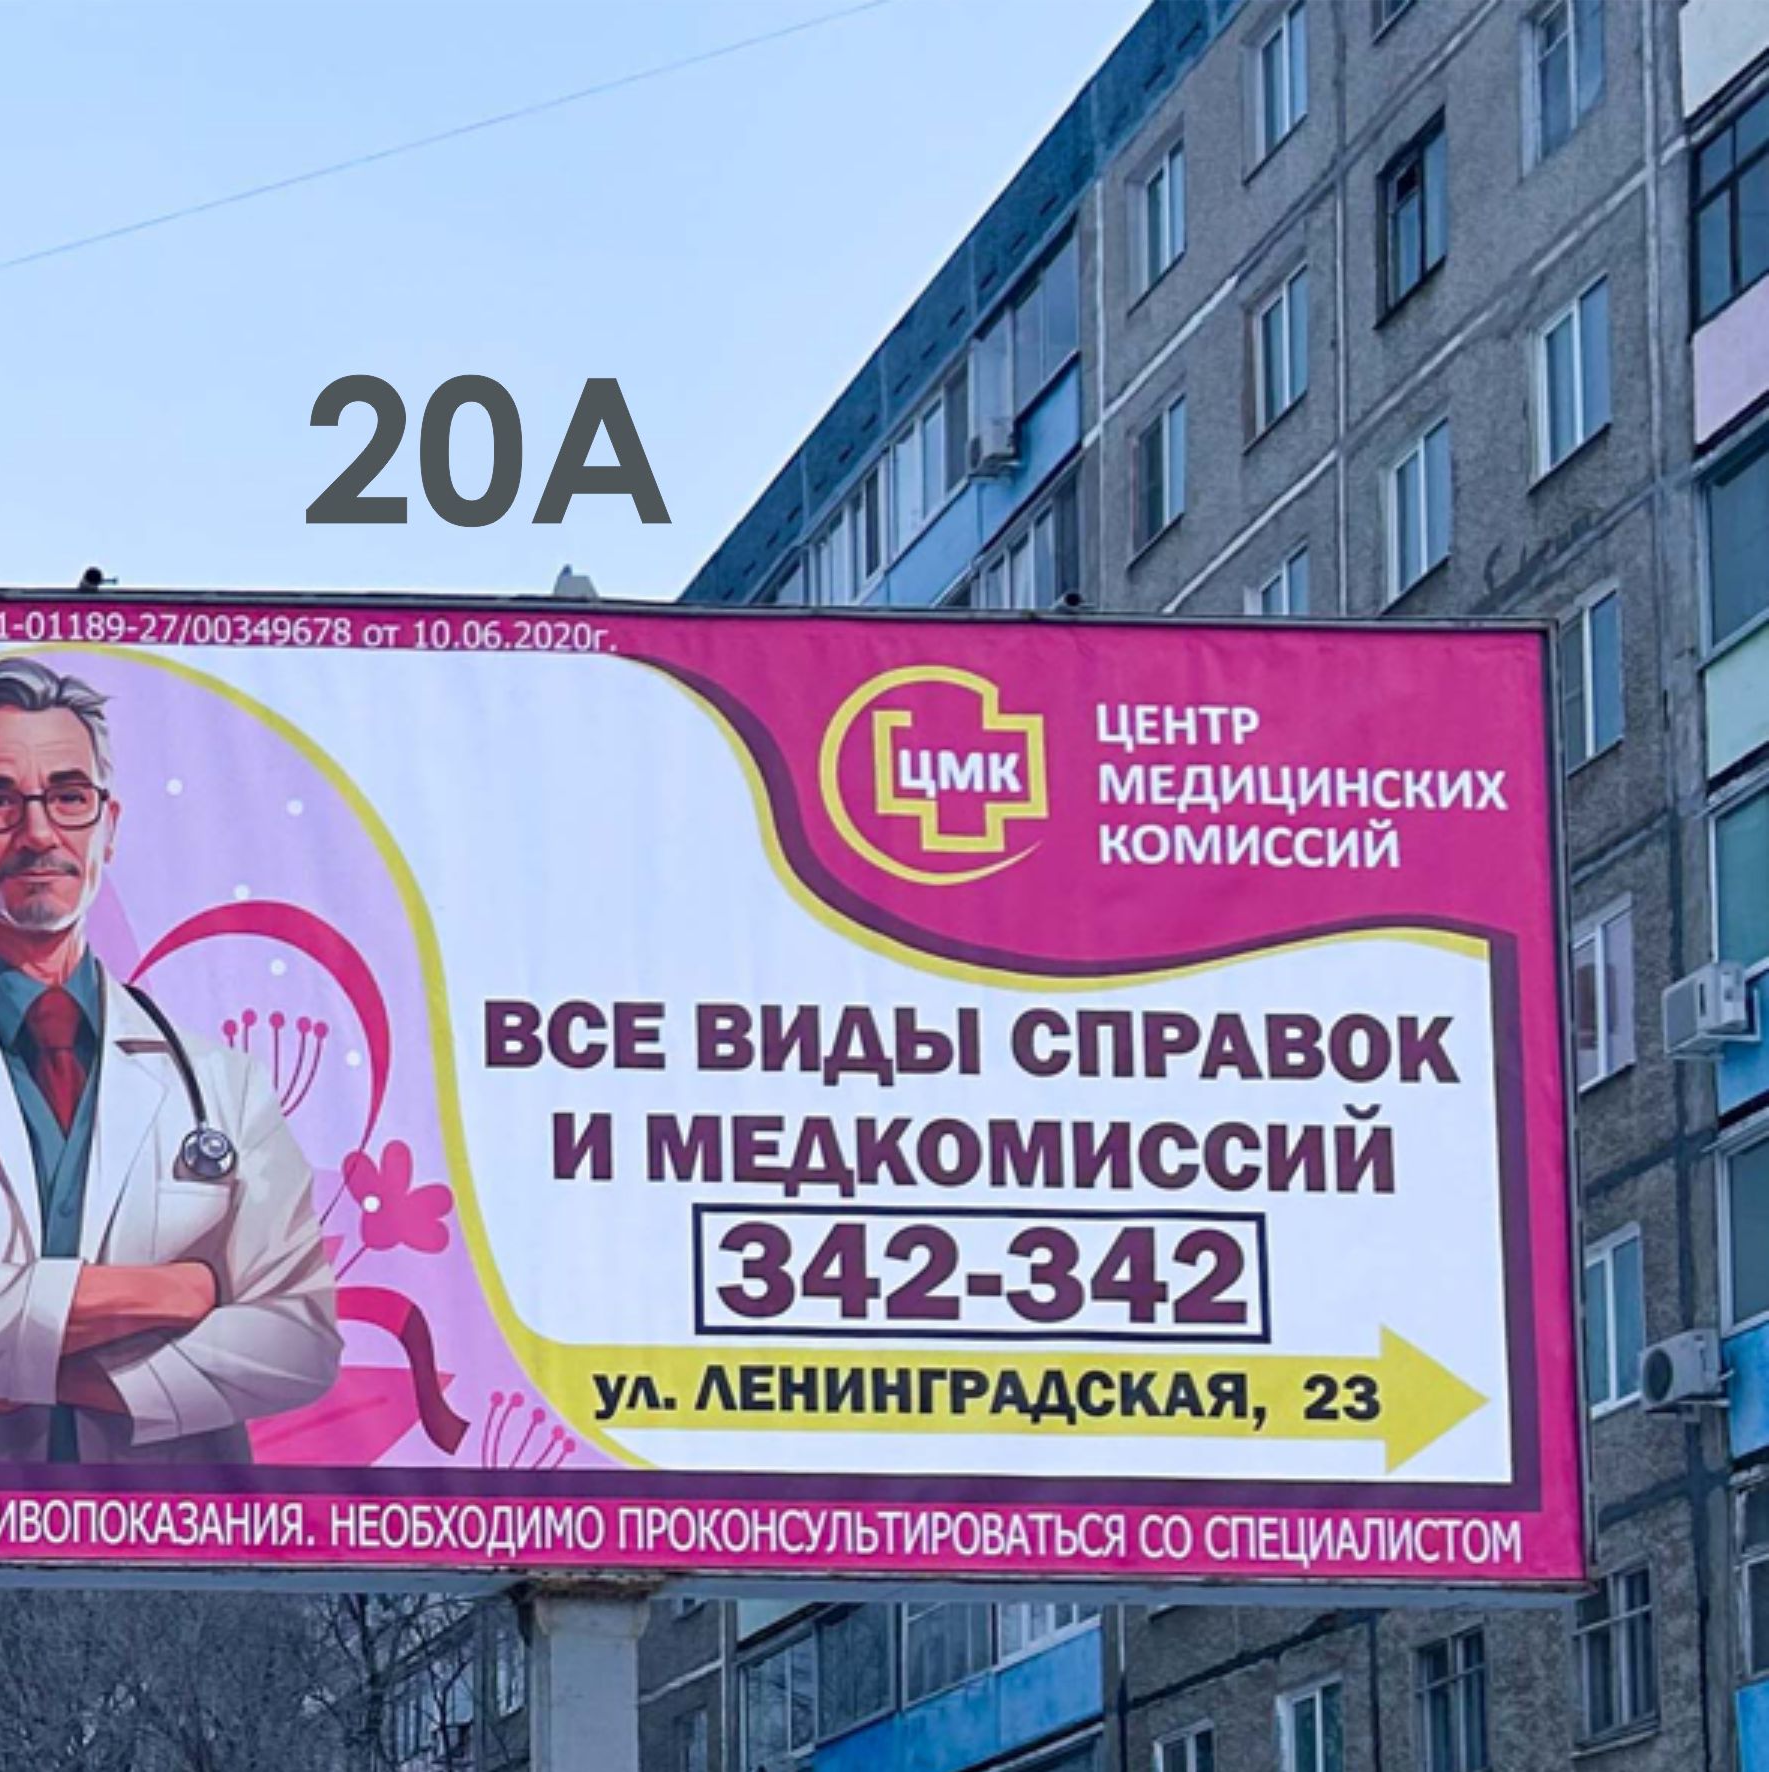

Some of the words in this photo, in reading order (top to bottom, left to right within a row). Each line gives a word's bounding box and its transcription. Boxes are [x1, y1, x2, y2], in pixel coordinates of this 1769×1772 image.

[363, 624, 398, 649] от
[412, 619, 618, 654] 10.06.2020г.
[1096, 703, 1261, 753] ЦЕНТР
[898, 748, 1023, 798] ЦМК
[1097, 763, 1509, 816] МЕДИЦИНСКИХ
[1098, 818, 1401, 869] КОМИССИЙ
[484, 1000, 666, 1070] ВСЕ
[696, 1004, 981, 1087] ВИДЫ
[1011, 1008, 1460, 1084] СПРАВОК
[551, 1111, 613, 1182] И
[645, 1104, 1396, 1198] МЕДКОМИССИЙ
[716, 1221, 1249, 1325] 342-342
[593, 1373, 678, 1417] ул.
[694, 1365, 1268, 1431] ЛЕНИНГРАДСКАЯ,
[1302, 1373, 1381, 1421] 23
[329, 1504, 605, 1557] НЕОБХОДИМО
[618, 1508, 1126, 1561] ПРОКОНСУЛЬТИРОВАТЬСЯ
[1138, 1515, 1193, 1560] СО
[1203, 1515, 1522, 1568] СПЕЦИАЛИСТОМ
